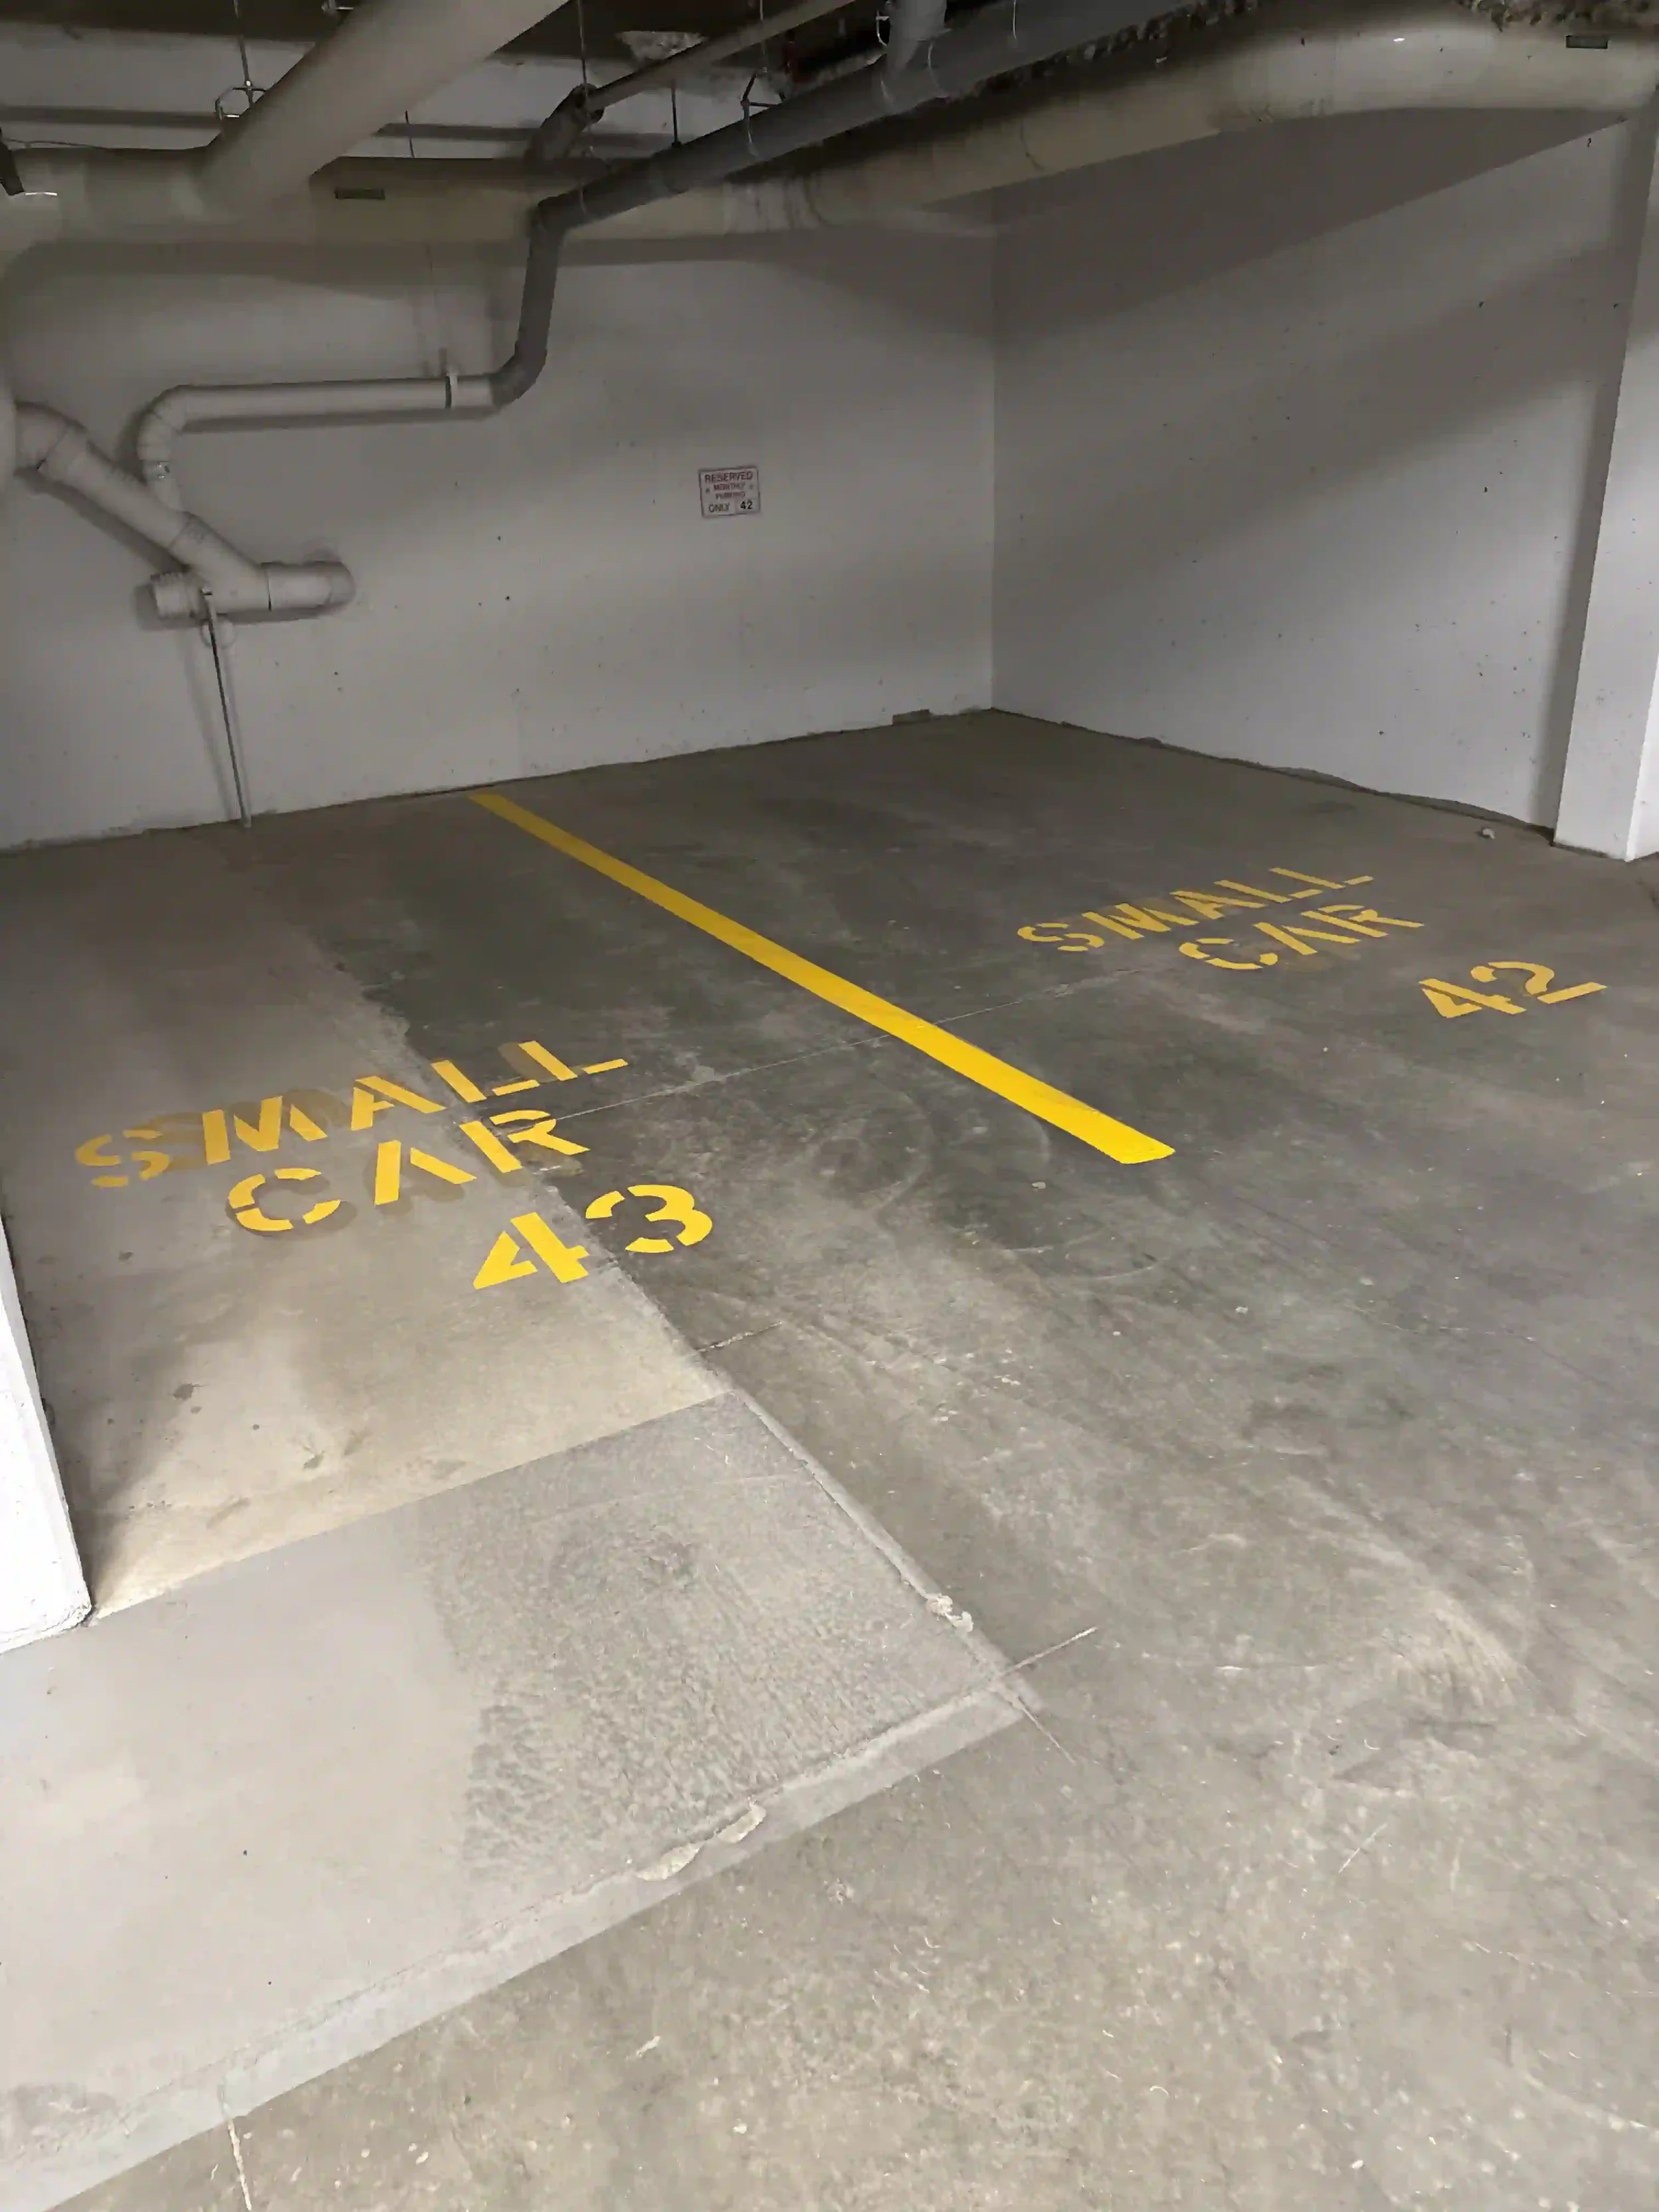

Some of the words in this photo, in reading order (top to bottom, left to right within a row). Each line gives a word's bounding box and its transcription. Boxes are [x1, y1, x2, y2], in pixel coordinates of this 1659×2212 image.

[704, 471, 753, 483] RESERVED
[708, 502, 730, 512] ONLY
[740, 499, 753, 510] 42
[1017, 867, 1374, 952] SMALL
[1179, 905, 1425, 970] CAR
[1419, 961, 1607, 1019] 42
[76, 1041, 628, 1187] SMALL
[228, 1109, 591, 1232] CAR
[473, 1184, 713, 1290] 43
